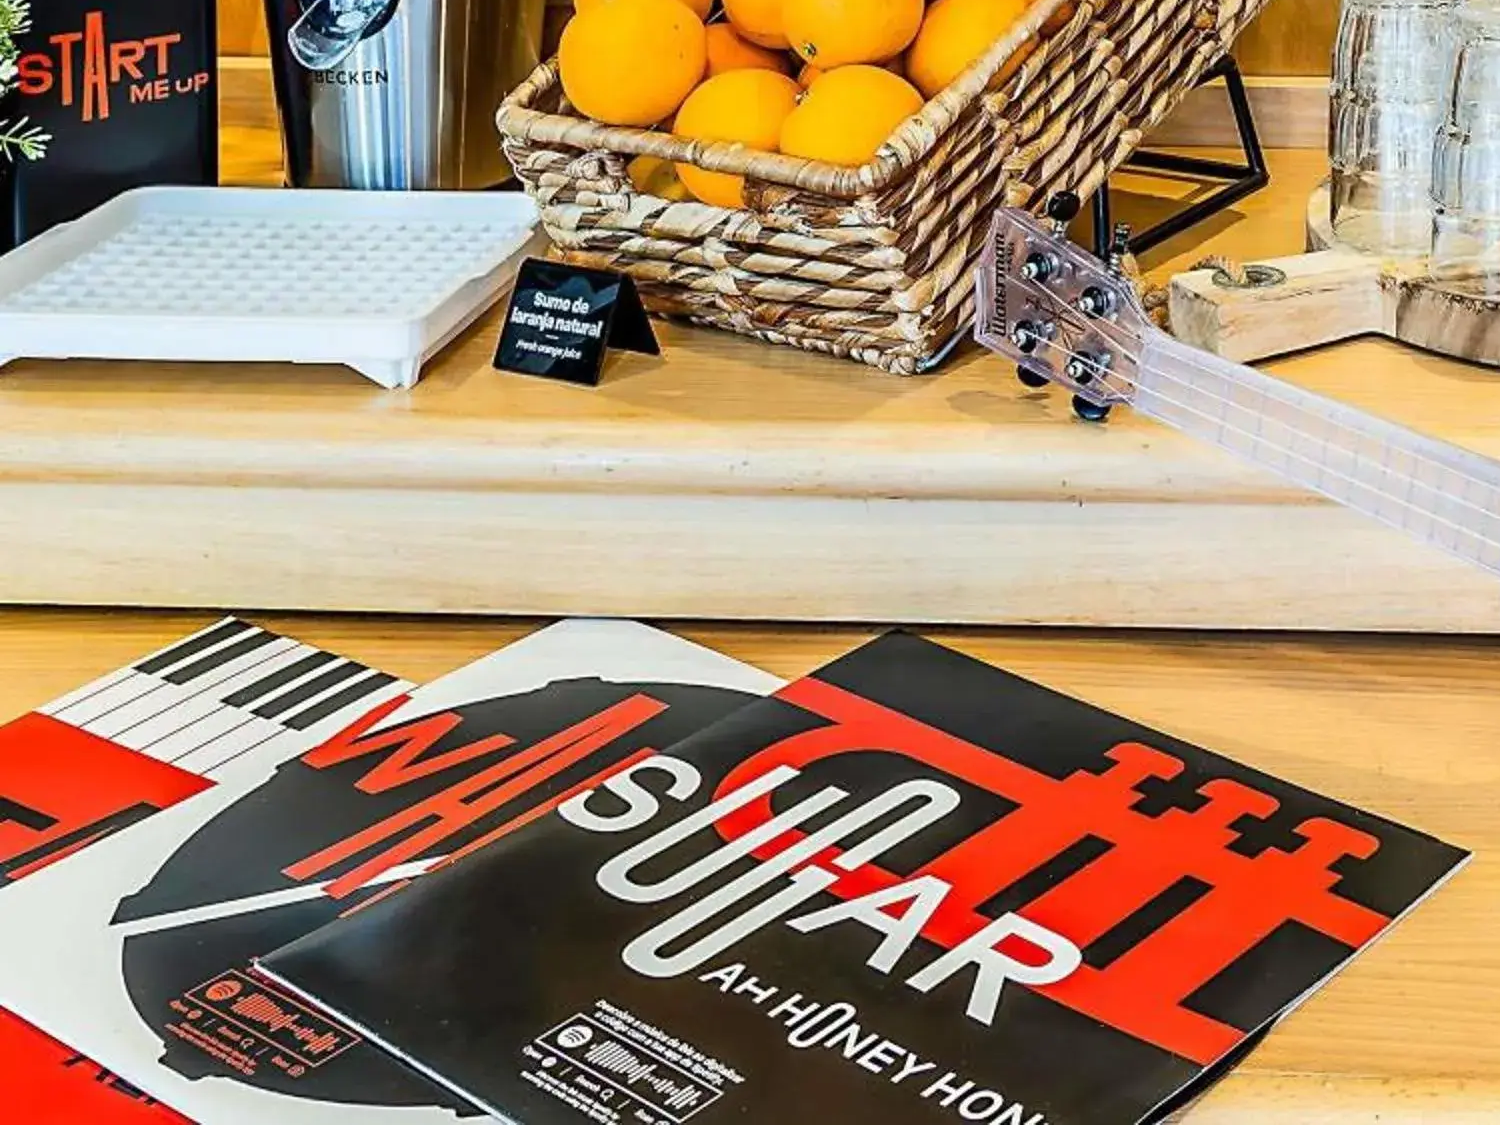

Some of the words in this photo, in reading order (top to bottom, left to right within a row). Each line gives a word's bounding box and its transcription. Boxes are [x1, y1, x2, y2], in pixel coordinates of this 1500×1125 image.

[17, 10, 182, 123] START
[314, 69, 388, 86] BECKEN
[129, 80, 170, 104] ME
[174, 72, 210, 94] UP
[534, 290, 571, 312] Sumo
[571, 296, 590, 316] de
[509, 306, 555, 333] laranja
[554, 317, 604, 338] natural
[699, 963, 779, 1005] AH
[766, 992, 937, 1085] HONEY
[919, 1071, 1048, 1125] HON
